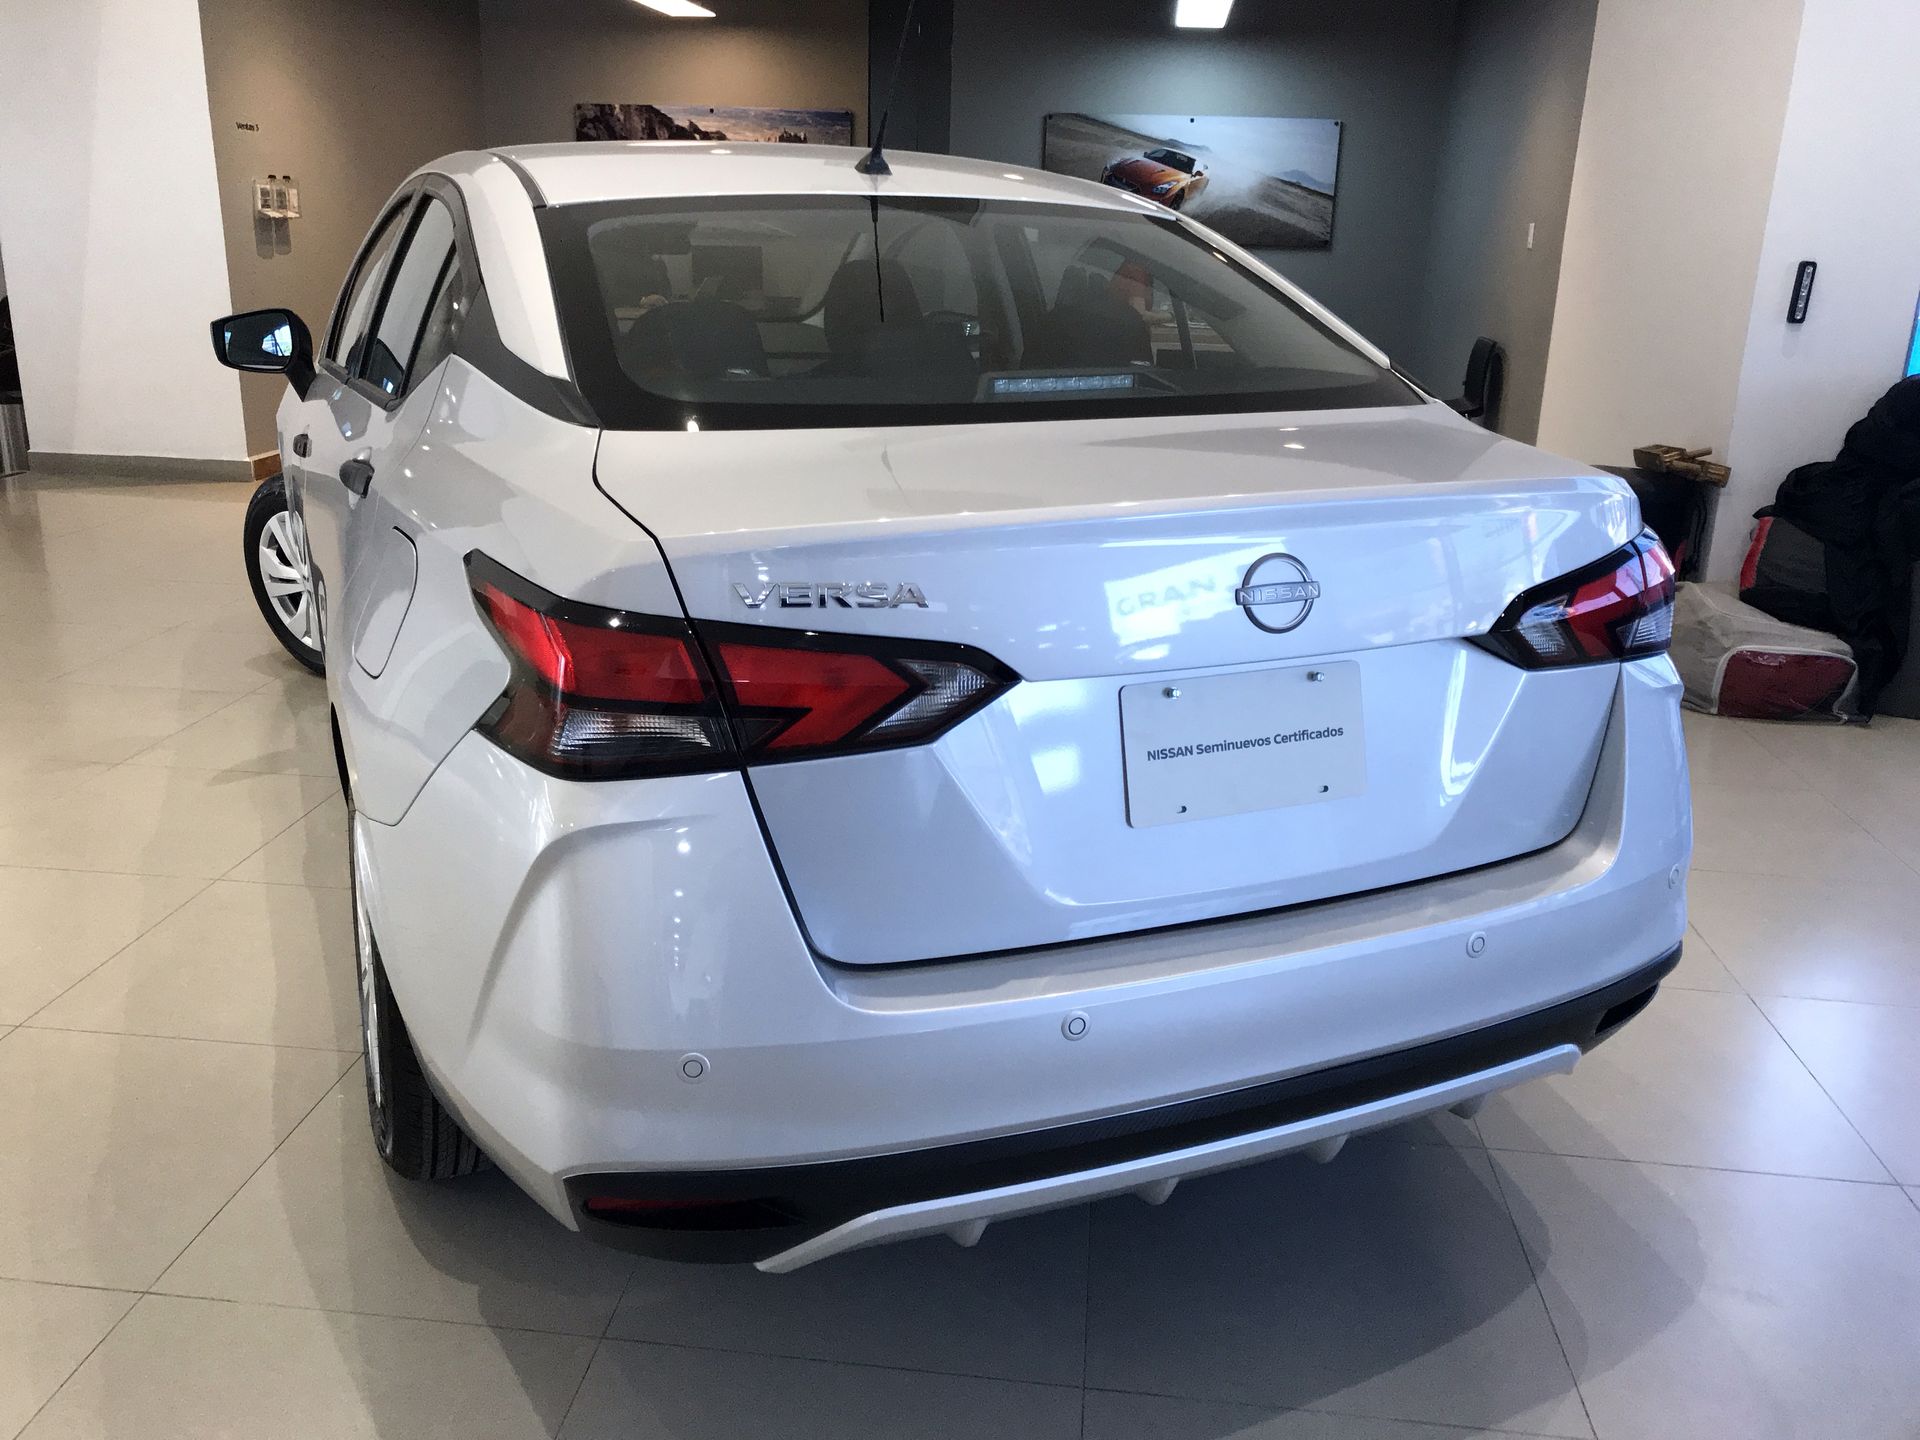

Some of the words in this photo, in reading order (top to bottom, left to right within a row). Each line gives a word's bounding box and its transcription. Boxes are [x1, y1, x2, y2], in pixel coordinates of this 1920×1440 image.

[732, 582, 930, 609] VERSA
[1239, 583, 1320, 604] NISSAN
[1147, 745, 1194, 761] NISSAN
[1196, 737, 1271, 755] Seminuevos
[1273, 726, 1344, 745] Certificados
